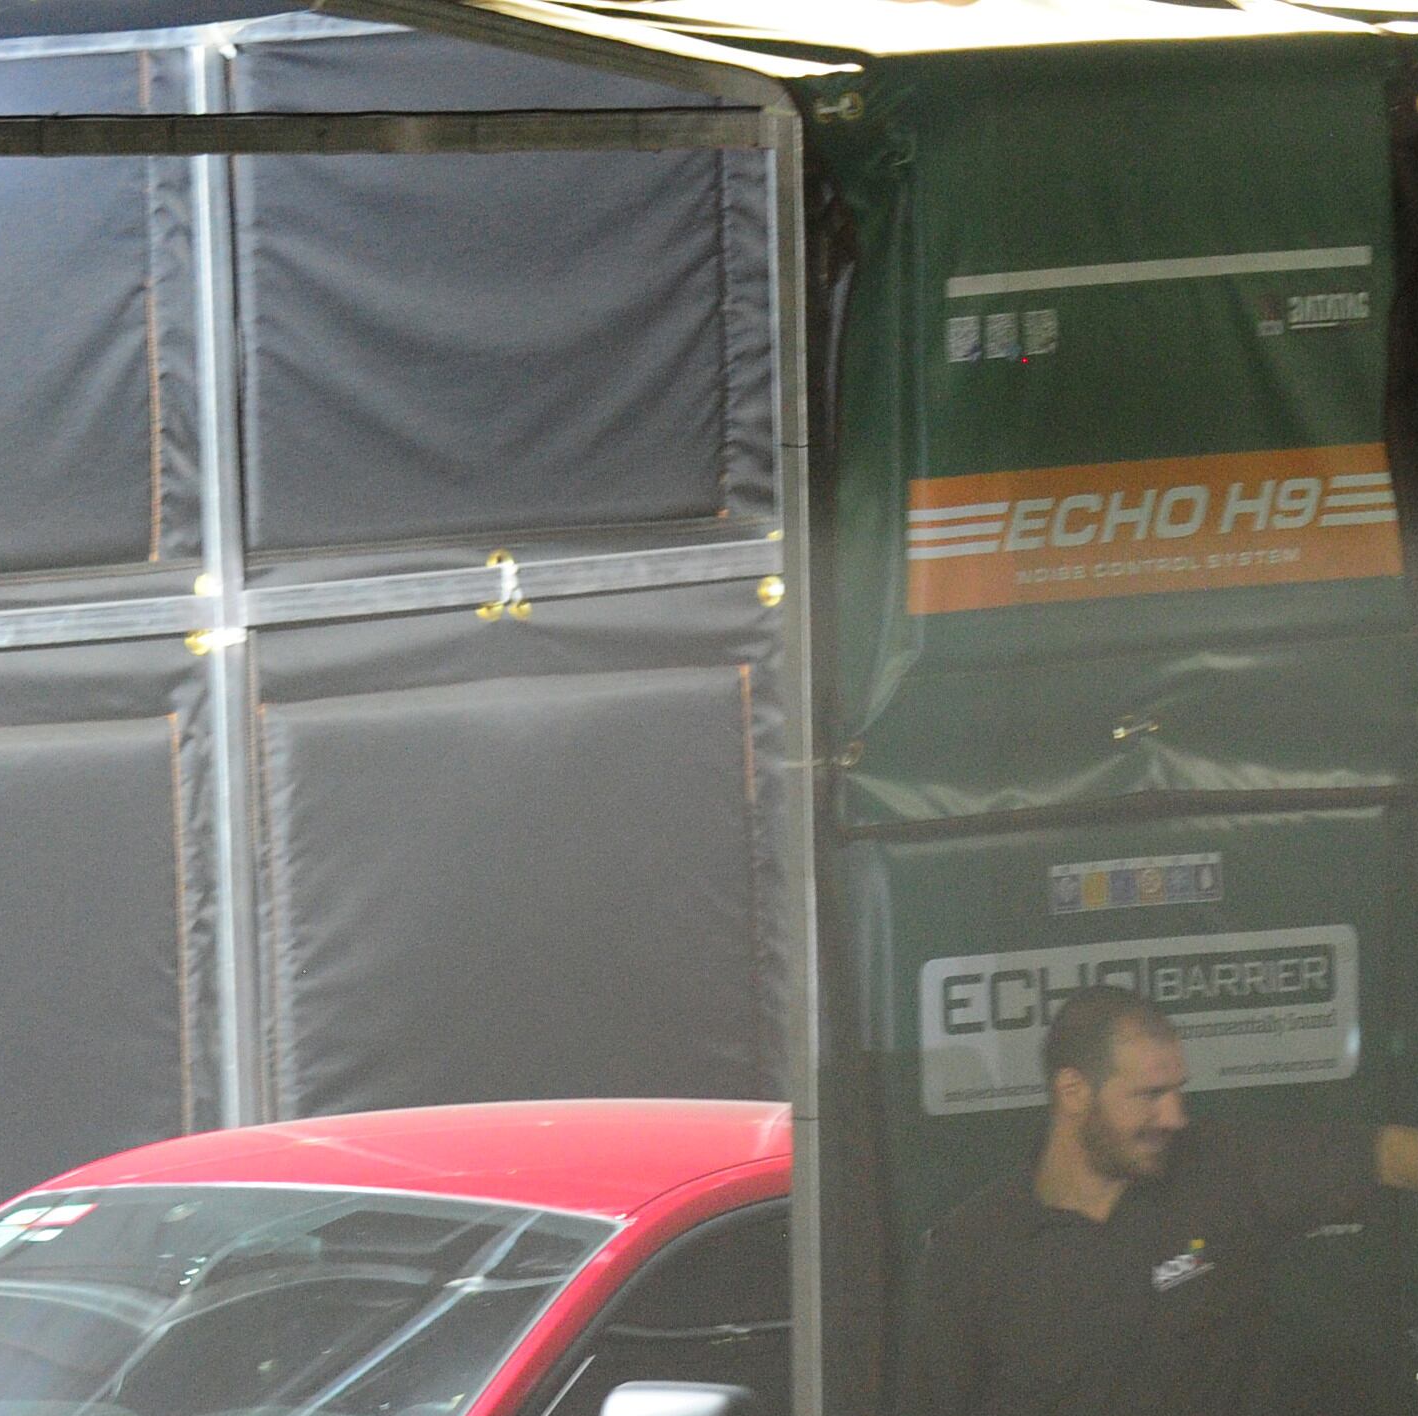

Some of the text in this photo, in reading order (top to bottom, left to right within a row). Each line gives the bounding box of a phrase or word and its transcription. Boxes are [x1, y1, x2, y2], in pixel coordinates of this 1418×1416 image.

[1005, 476, 1323, 552] ECHO H9
[1015, 547, 1302, 585] NOISE CONTROL SYSTEM
[1154, 954, 1331, 1002] BARRIER
